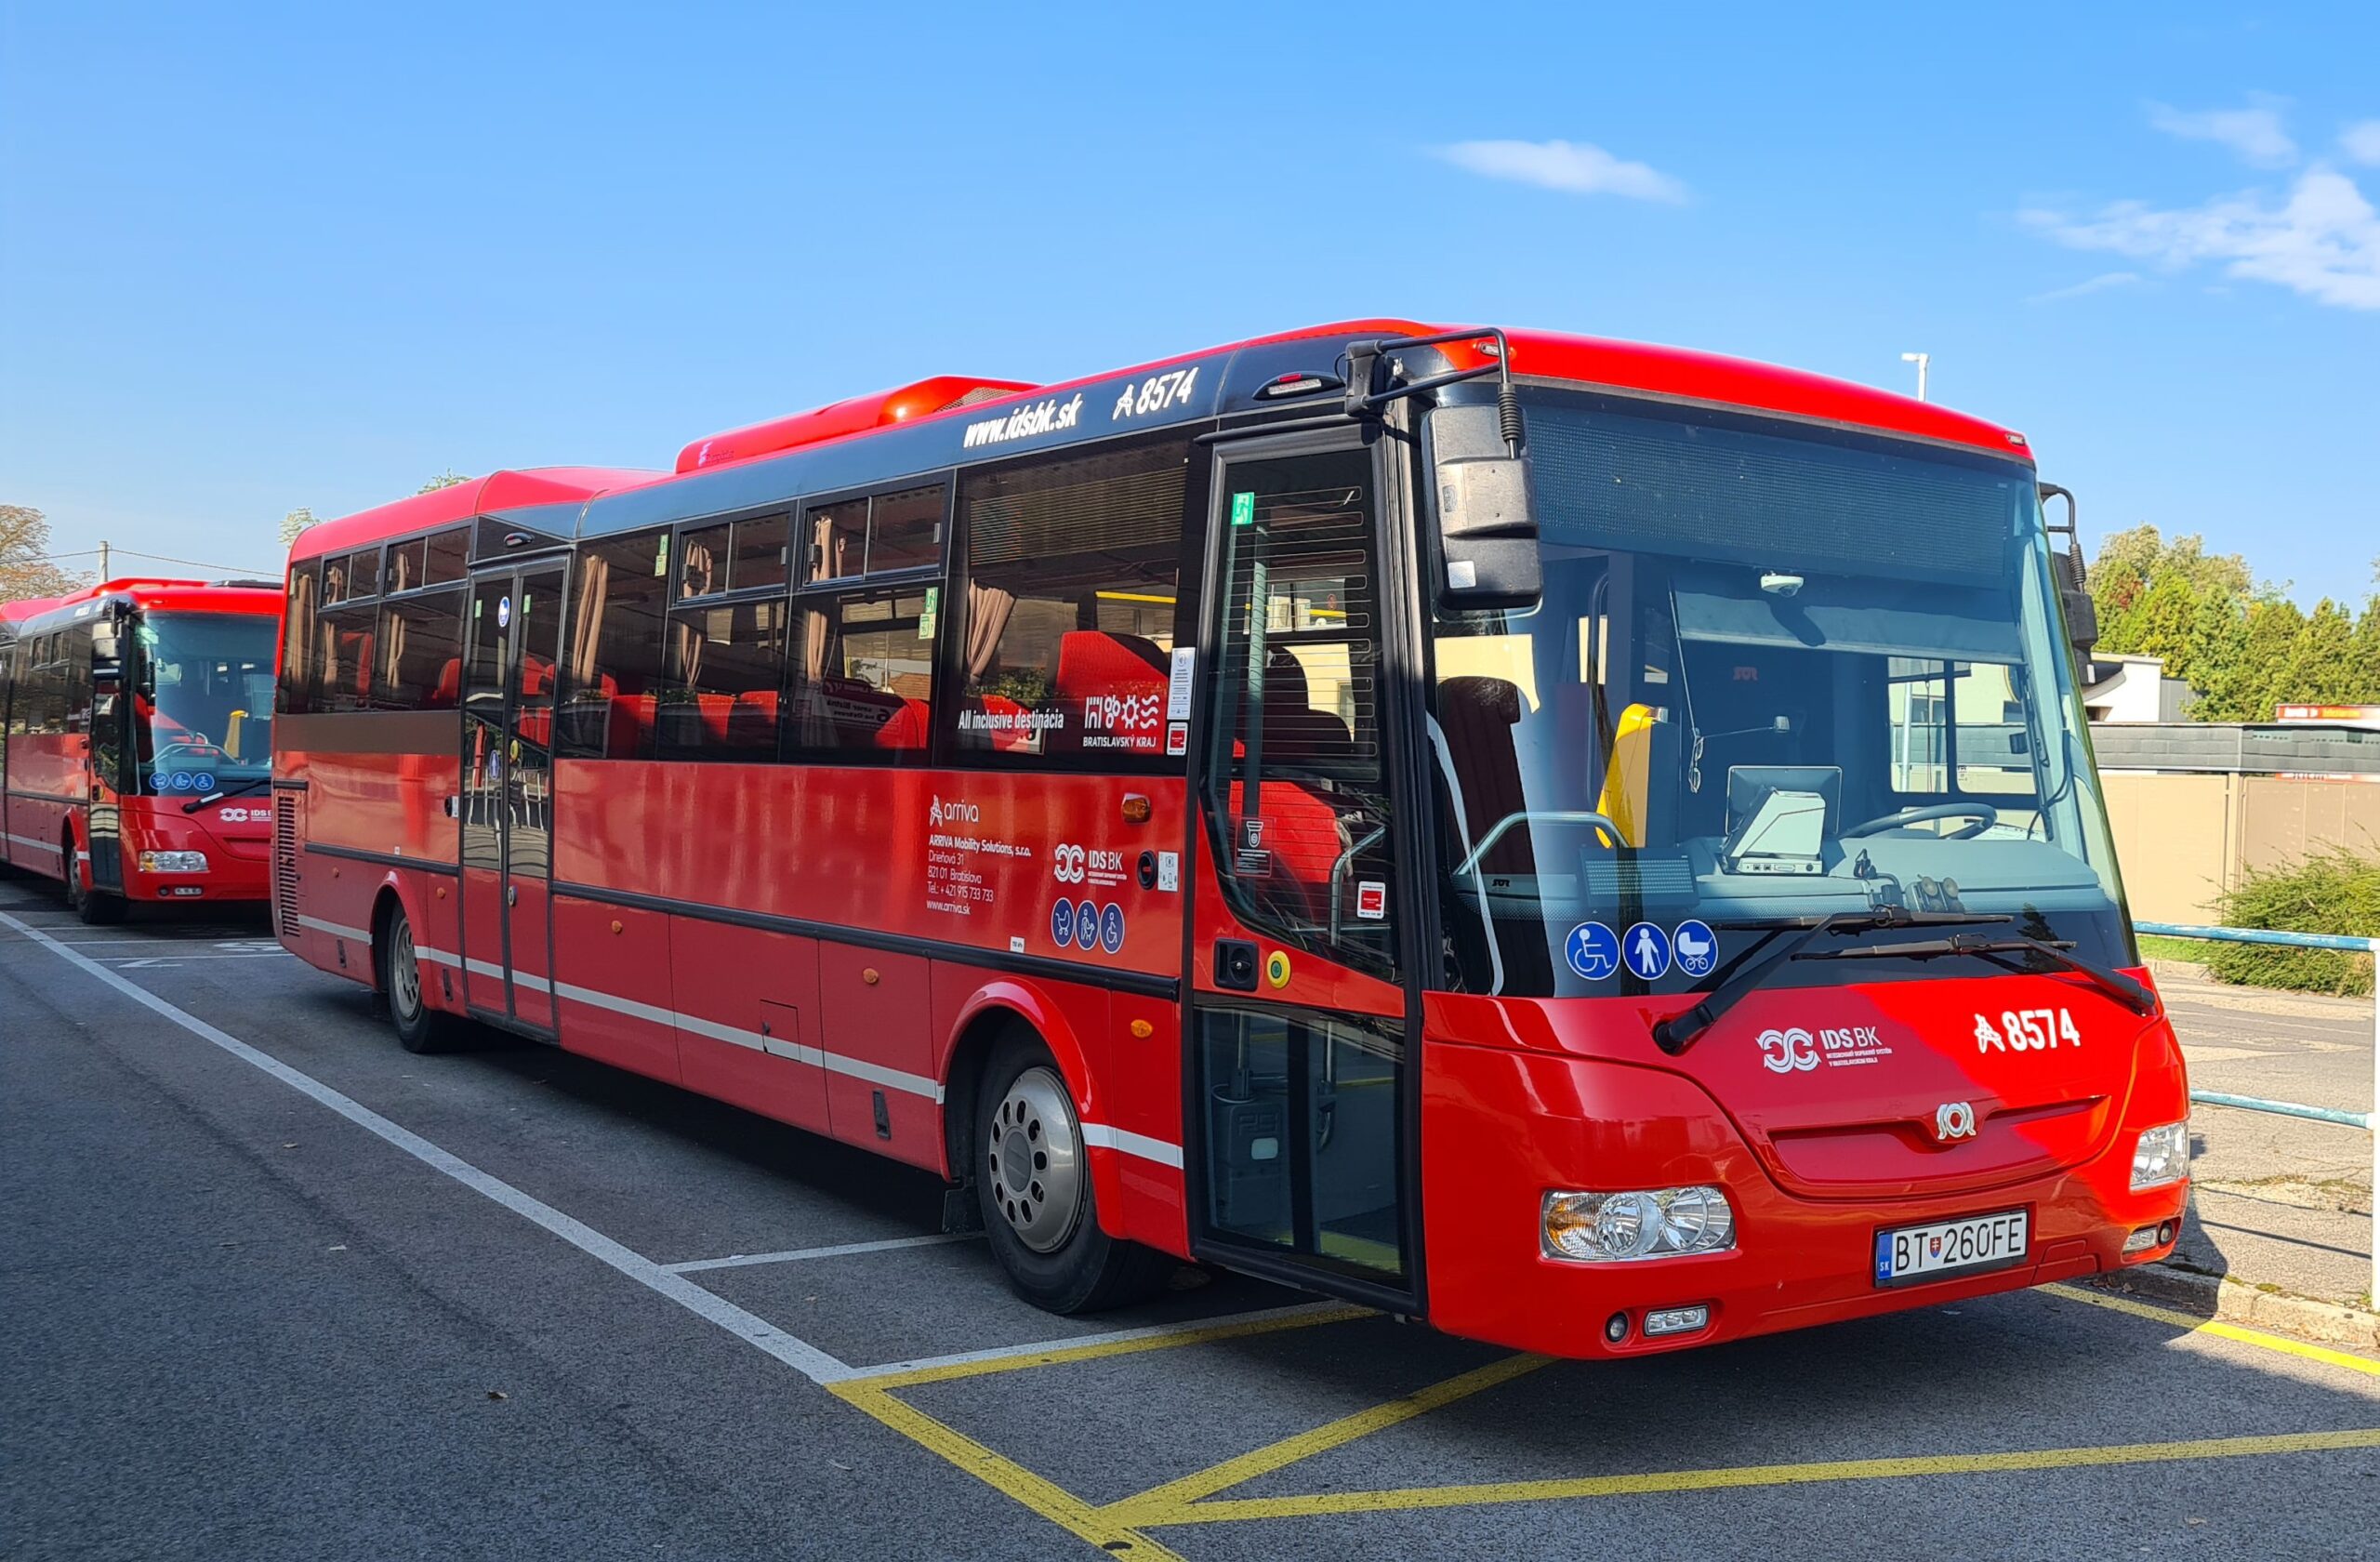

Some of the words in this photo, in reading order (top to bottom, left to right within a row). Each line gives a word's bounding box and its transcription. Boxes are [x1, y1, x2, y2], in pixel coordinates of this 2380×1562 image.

[1136, 366, 1199, 415] 8574
[963, 392, 1084, 448] www.idsbk.sk
[959, 710, 971, 730] All
[972, 709, 1012, 729] inclusive
[1013, 708, 1064, 729] destinácia
[1083, 734, 1134, 748] BRATISLAVSKÝ
[1136, 736, 1157, 748] KRAJ
[944, 799, 979, 823] arriva
[929, 834, 953, 848] ARRIVA
[954, 836, 981, 854] Mobility
[981, 839, 1014, 857] Solutions,
[1015, 846, 1032, 857] s.r.o.
[1089, 850, 1107, 869] IDS
[1108, 851, 1123, 871] BK
[939, 867, 947, 880] 01
[950, 868, 982, 884] Bratislava
[926, 899, 971, 915] www.arriva.sk
[1819, 1028, 1854, 1050] IDS
[1853, 1026, 1882, 1048] BK
[2002, 1008, 2081, 1052] 8574
[1879, 1261, 1890, 1271] SK
[1896, 1232, 1928, 1272] BT
[1943, 1217, 2022, 1264] 260FE
